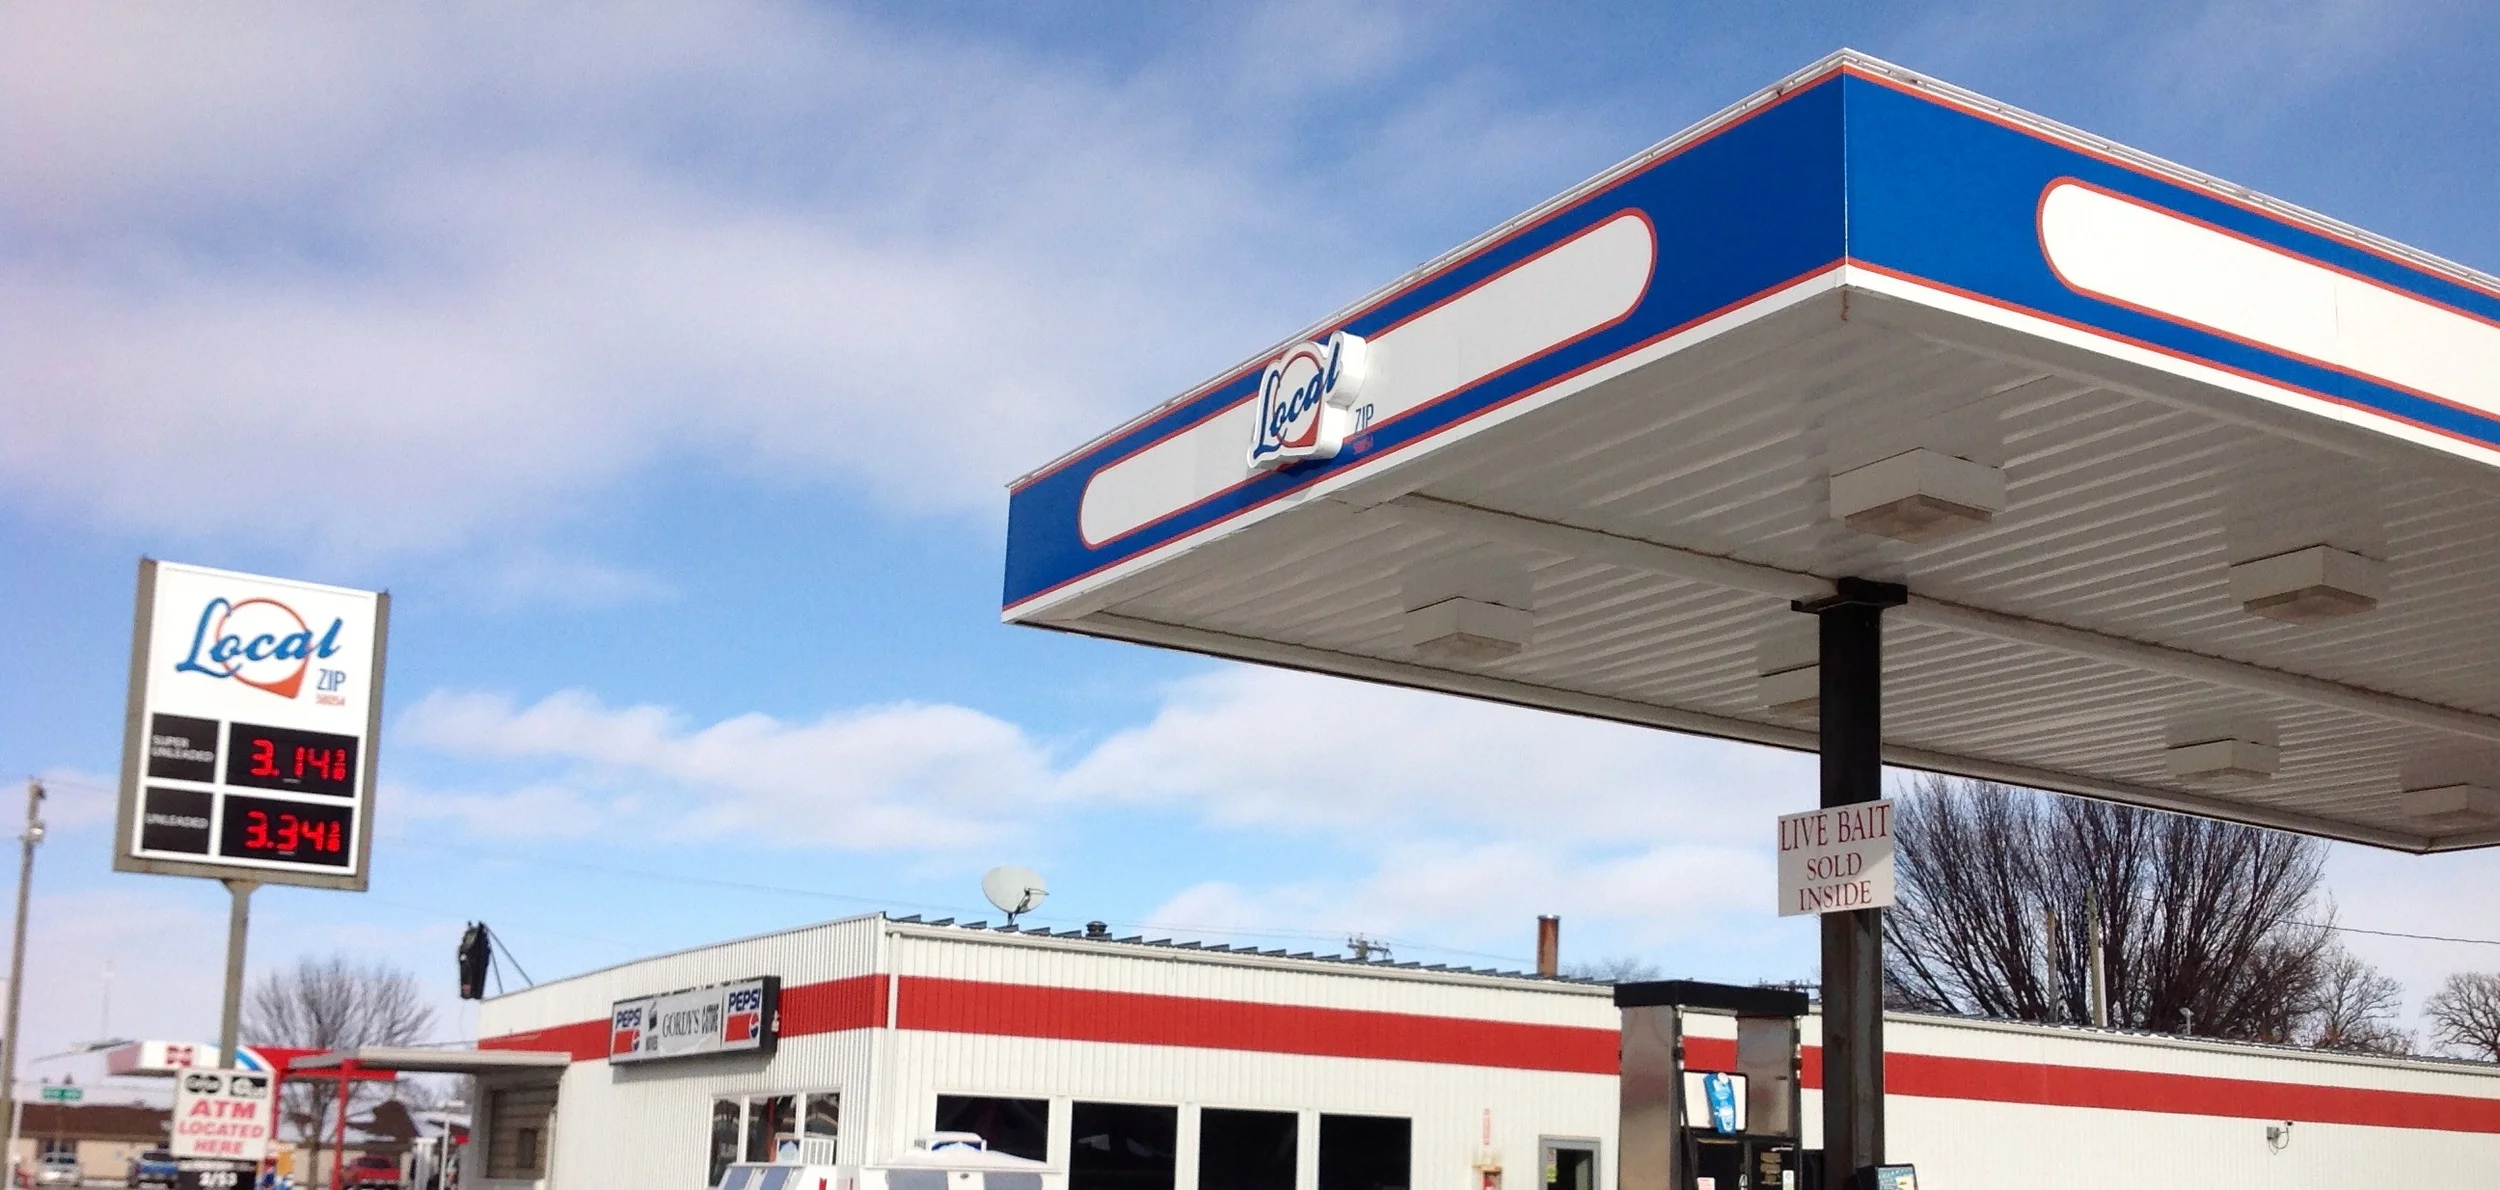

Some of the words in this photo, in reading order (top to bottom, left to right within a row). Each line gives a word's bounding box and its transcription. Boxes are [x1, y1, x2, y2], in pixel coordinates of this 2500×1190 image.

[1253, 341, 1340, 459] Local
[1355, 403, 1374, 435] ZIP
[174, 597, 343, 678] Local
[317, 668, 346, 691] ZIP
[1781, 814, 1829, 851] LIVE
[1837, 804, 1890, 843] BAIT
[1806, 852, 1862, 881] SOLD
[1799, 880, 1872, 911] INSIDE
[728, 988, 761, 1013] PEPSI
[615, 1007, 642, 1029] PEPSI
[189, 1100, 256, 1118] ATM
[179, 1122, 264, 1138] LOCATED
[193, 1140, 243, 1155] HERE
